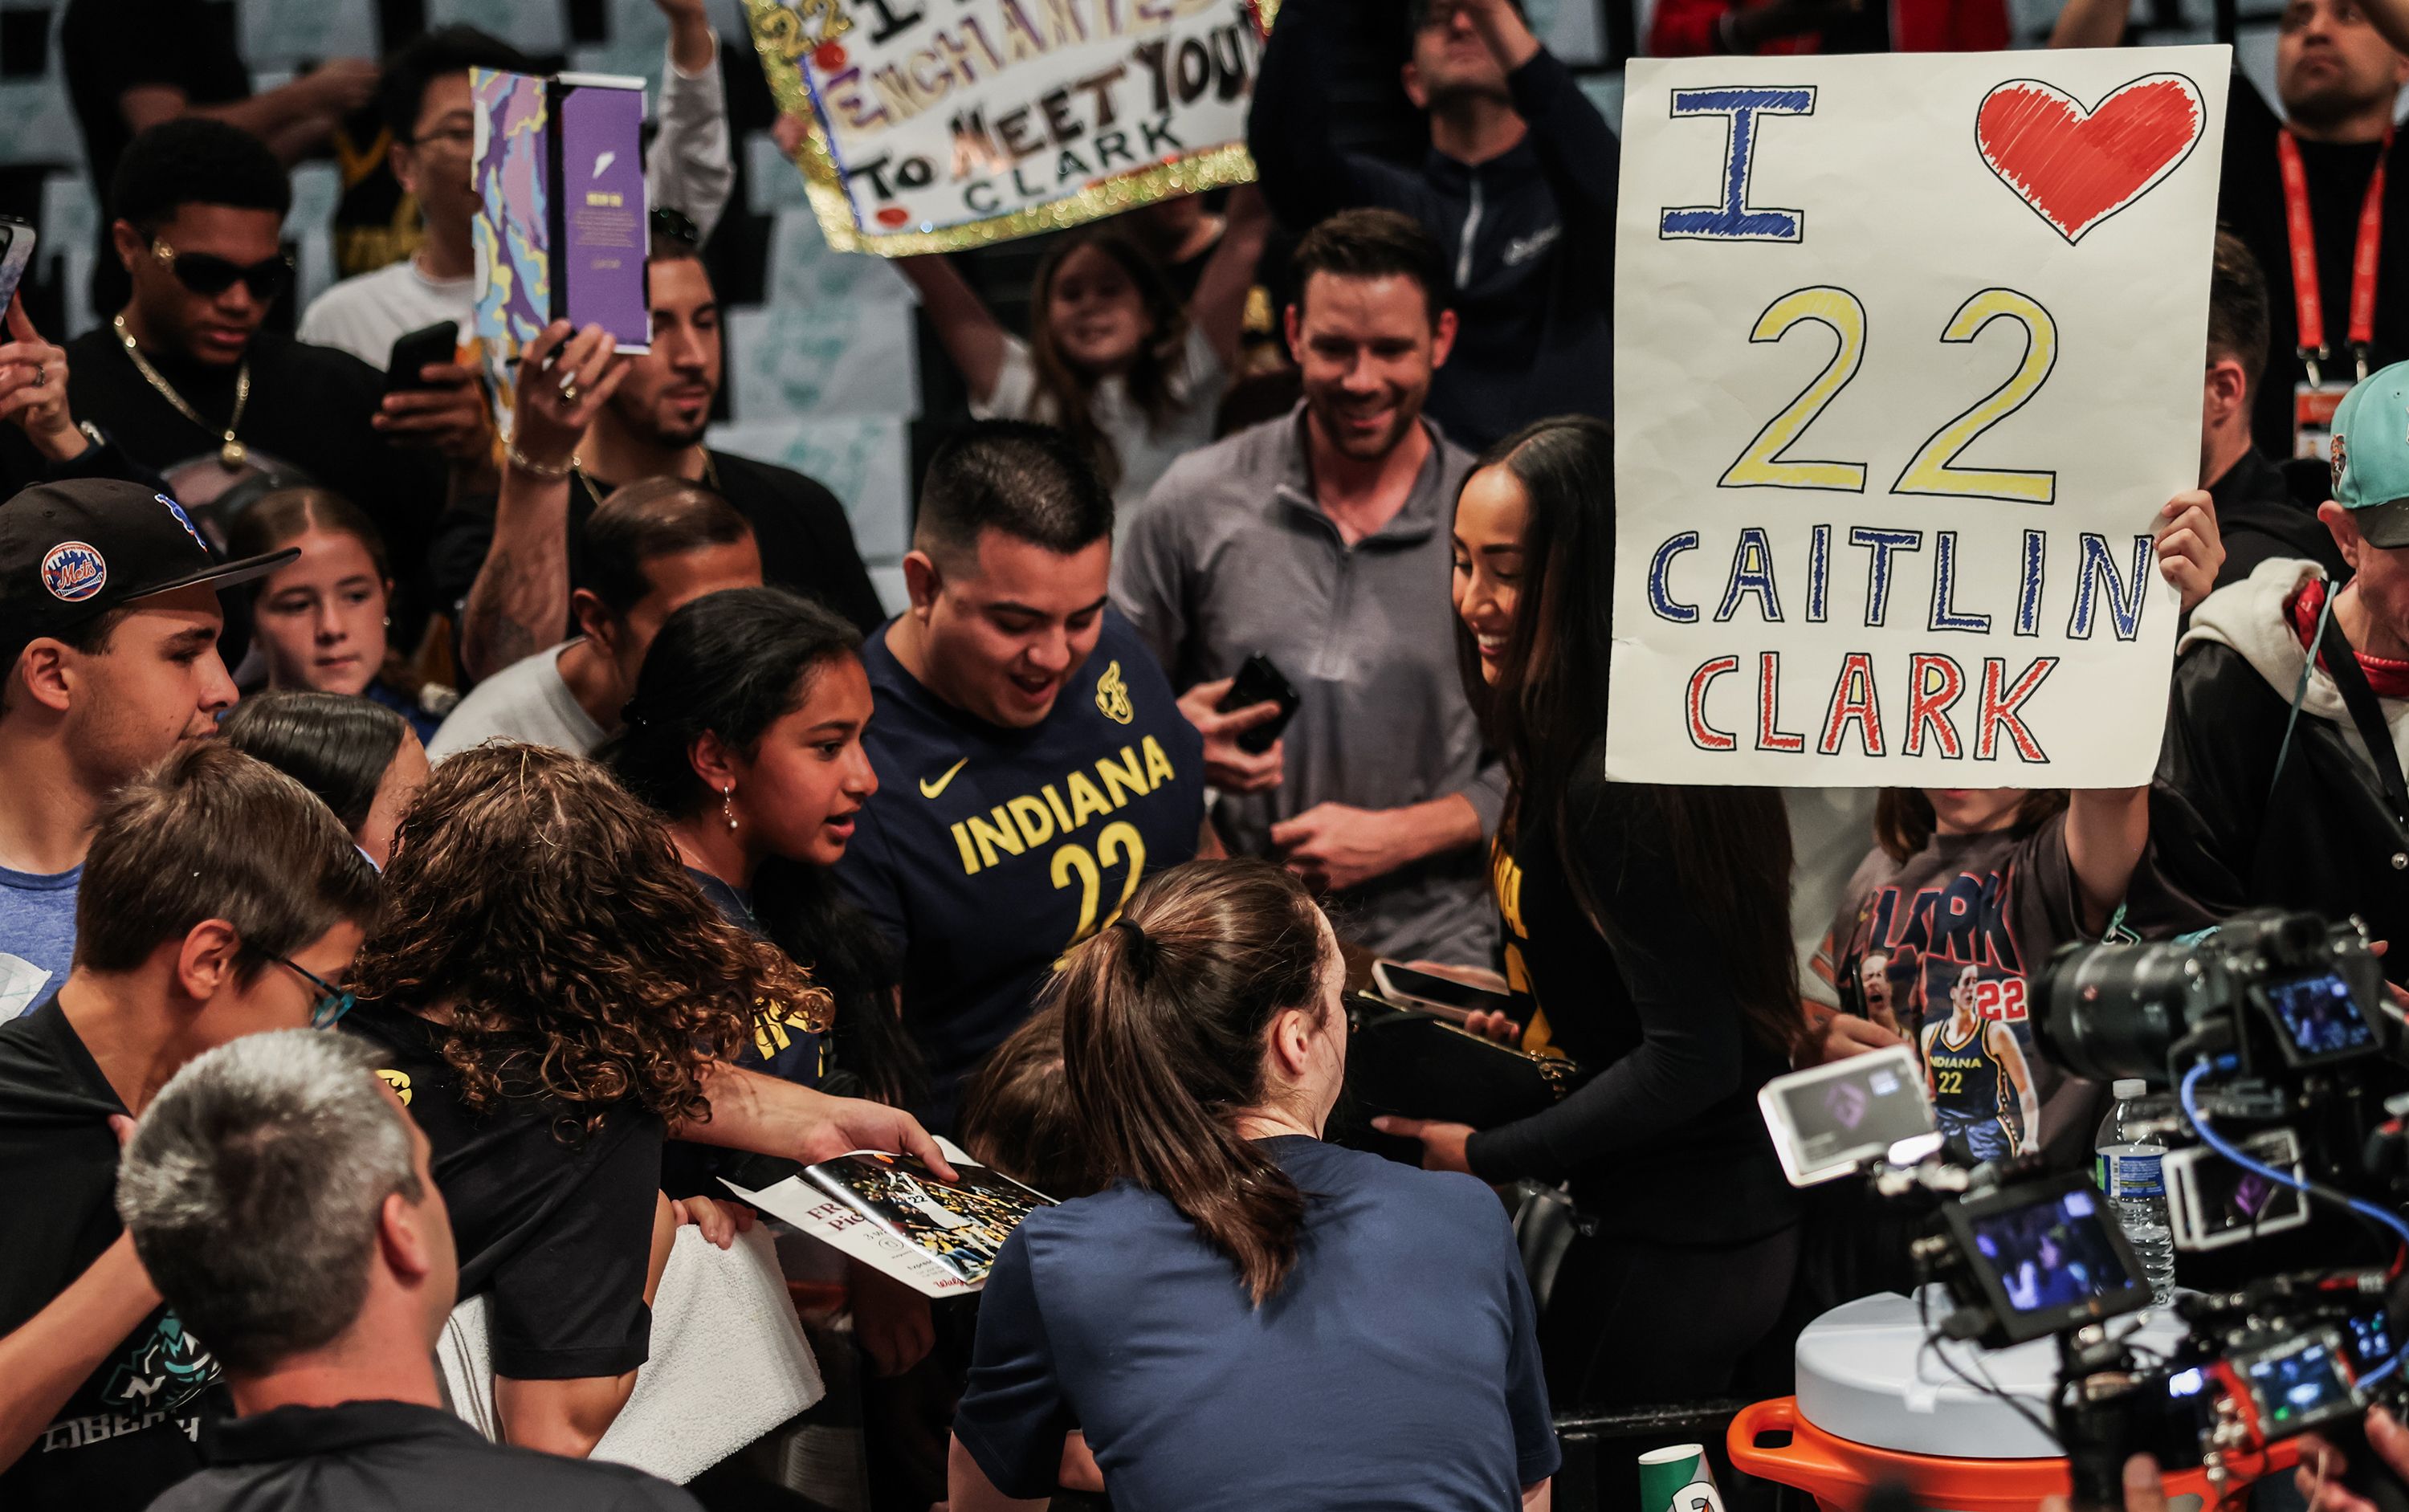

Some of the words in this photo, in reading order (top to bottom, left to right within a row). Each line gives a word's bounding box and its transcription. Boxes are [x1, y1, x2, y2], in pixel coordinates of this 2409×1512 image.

[964, 116, 1188, 215] CLARK
[1658, 85, 1818, 243] I
[1717, 284, 2057, 506] 22
[56, 558, 96, 589] Mets
[1647, 524, 2155, 642] CAITLIN
[1685, 650, 2060, 764] CLARK
[950, 734, 1176, 876] INDIANA
[1050, 820, 1147, 970] 22
[1857, 870, 2028, 977] LARK
[1975, 976, 2029, 1024] 22
[1929, 1055, 1983, 1070] NDIANA
[1938, 1071, 1963, 1094] 22
[805, 1202, 843, 1221] FR
[908, 1194, 928, 1204] 22
